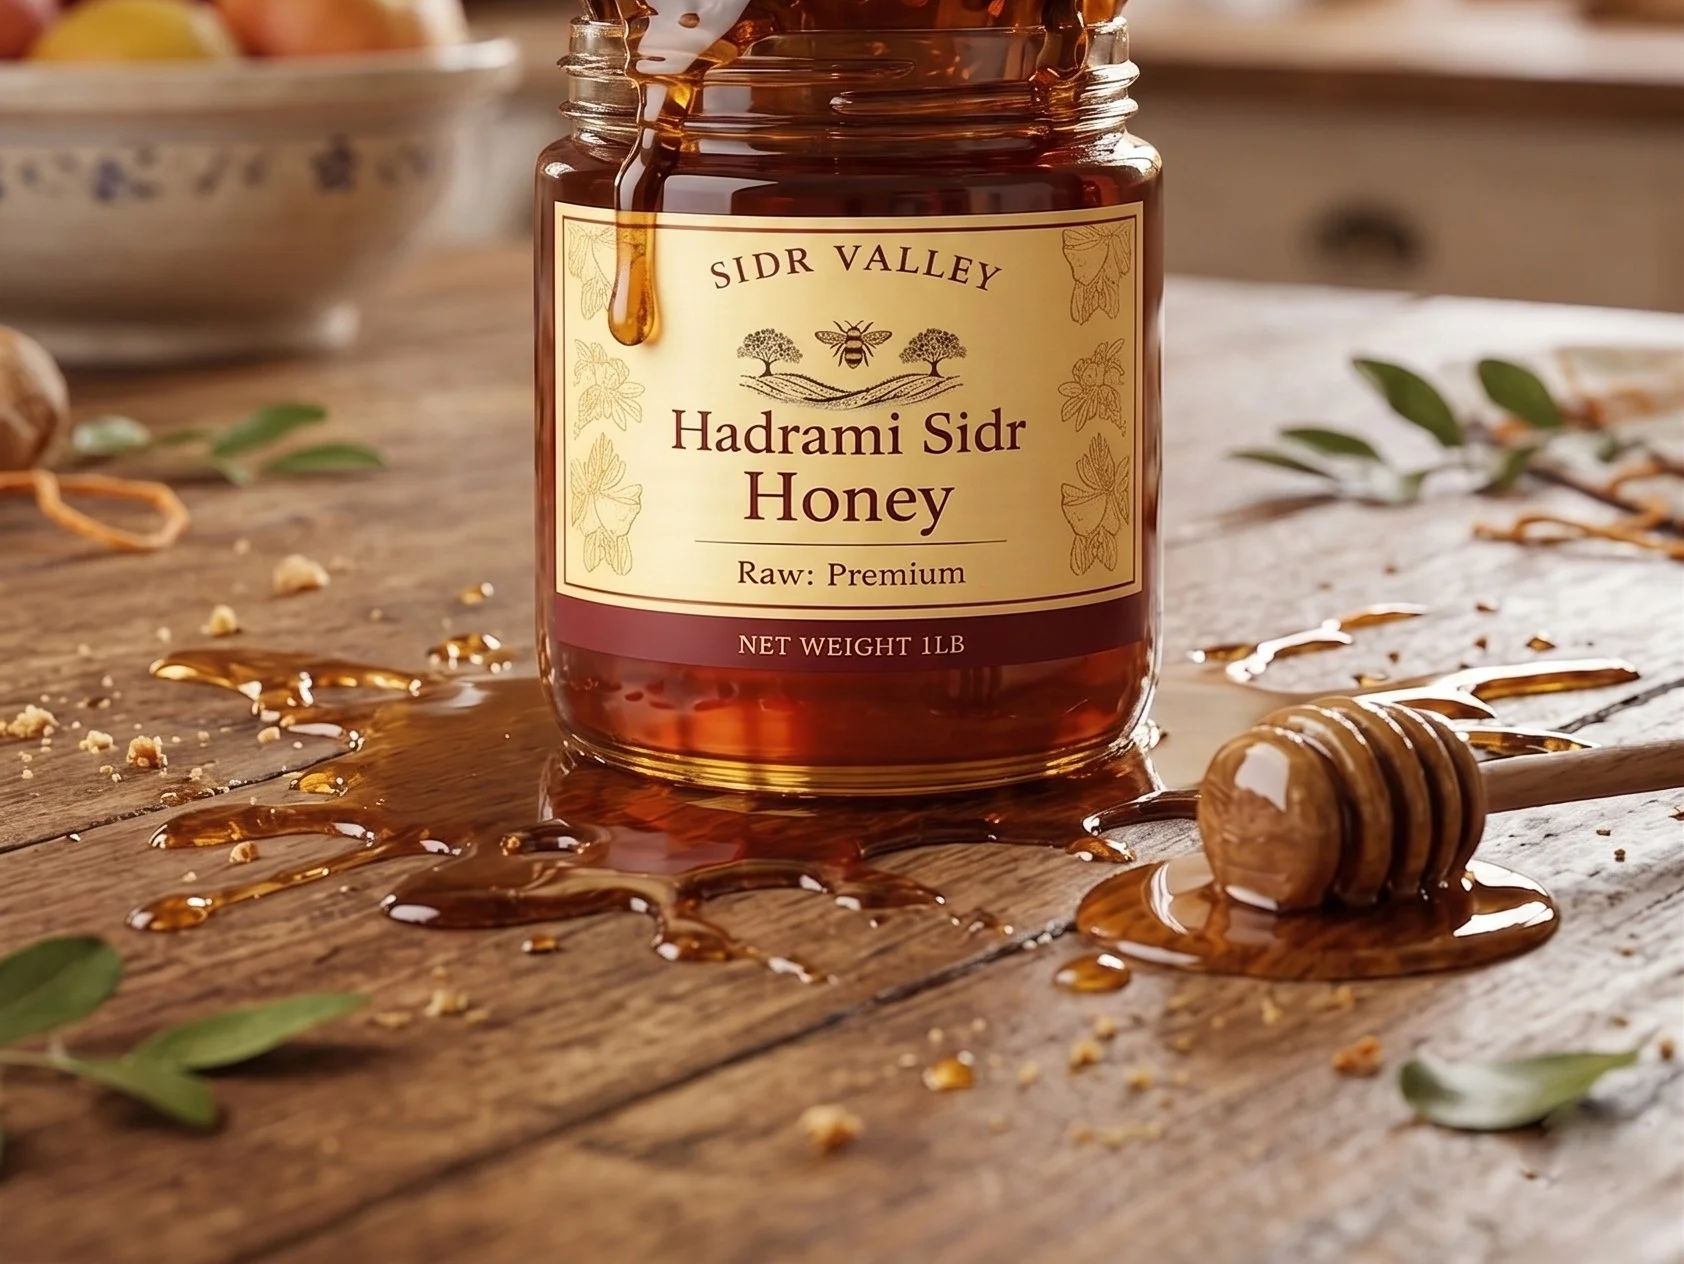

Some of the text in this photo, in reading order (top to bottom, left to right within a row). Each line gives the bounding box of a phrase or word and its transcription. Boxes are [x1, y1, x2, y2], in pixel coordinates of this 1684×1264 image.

[710, 244, 1003, 292] SIDR VALLEY
[671, 407, 1027, 456] Hadrami Sidr
[743, 471, 956, 536] Honey
[737, 560, 967, 588] Raw: Premium
[738, 634, 966, 658] NET WEIGHT 1LB
